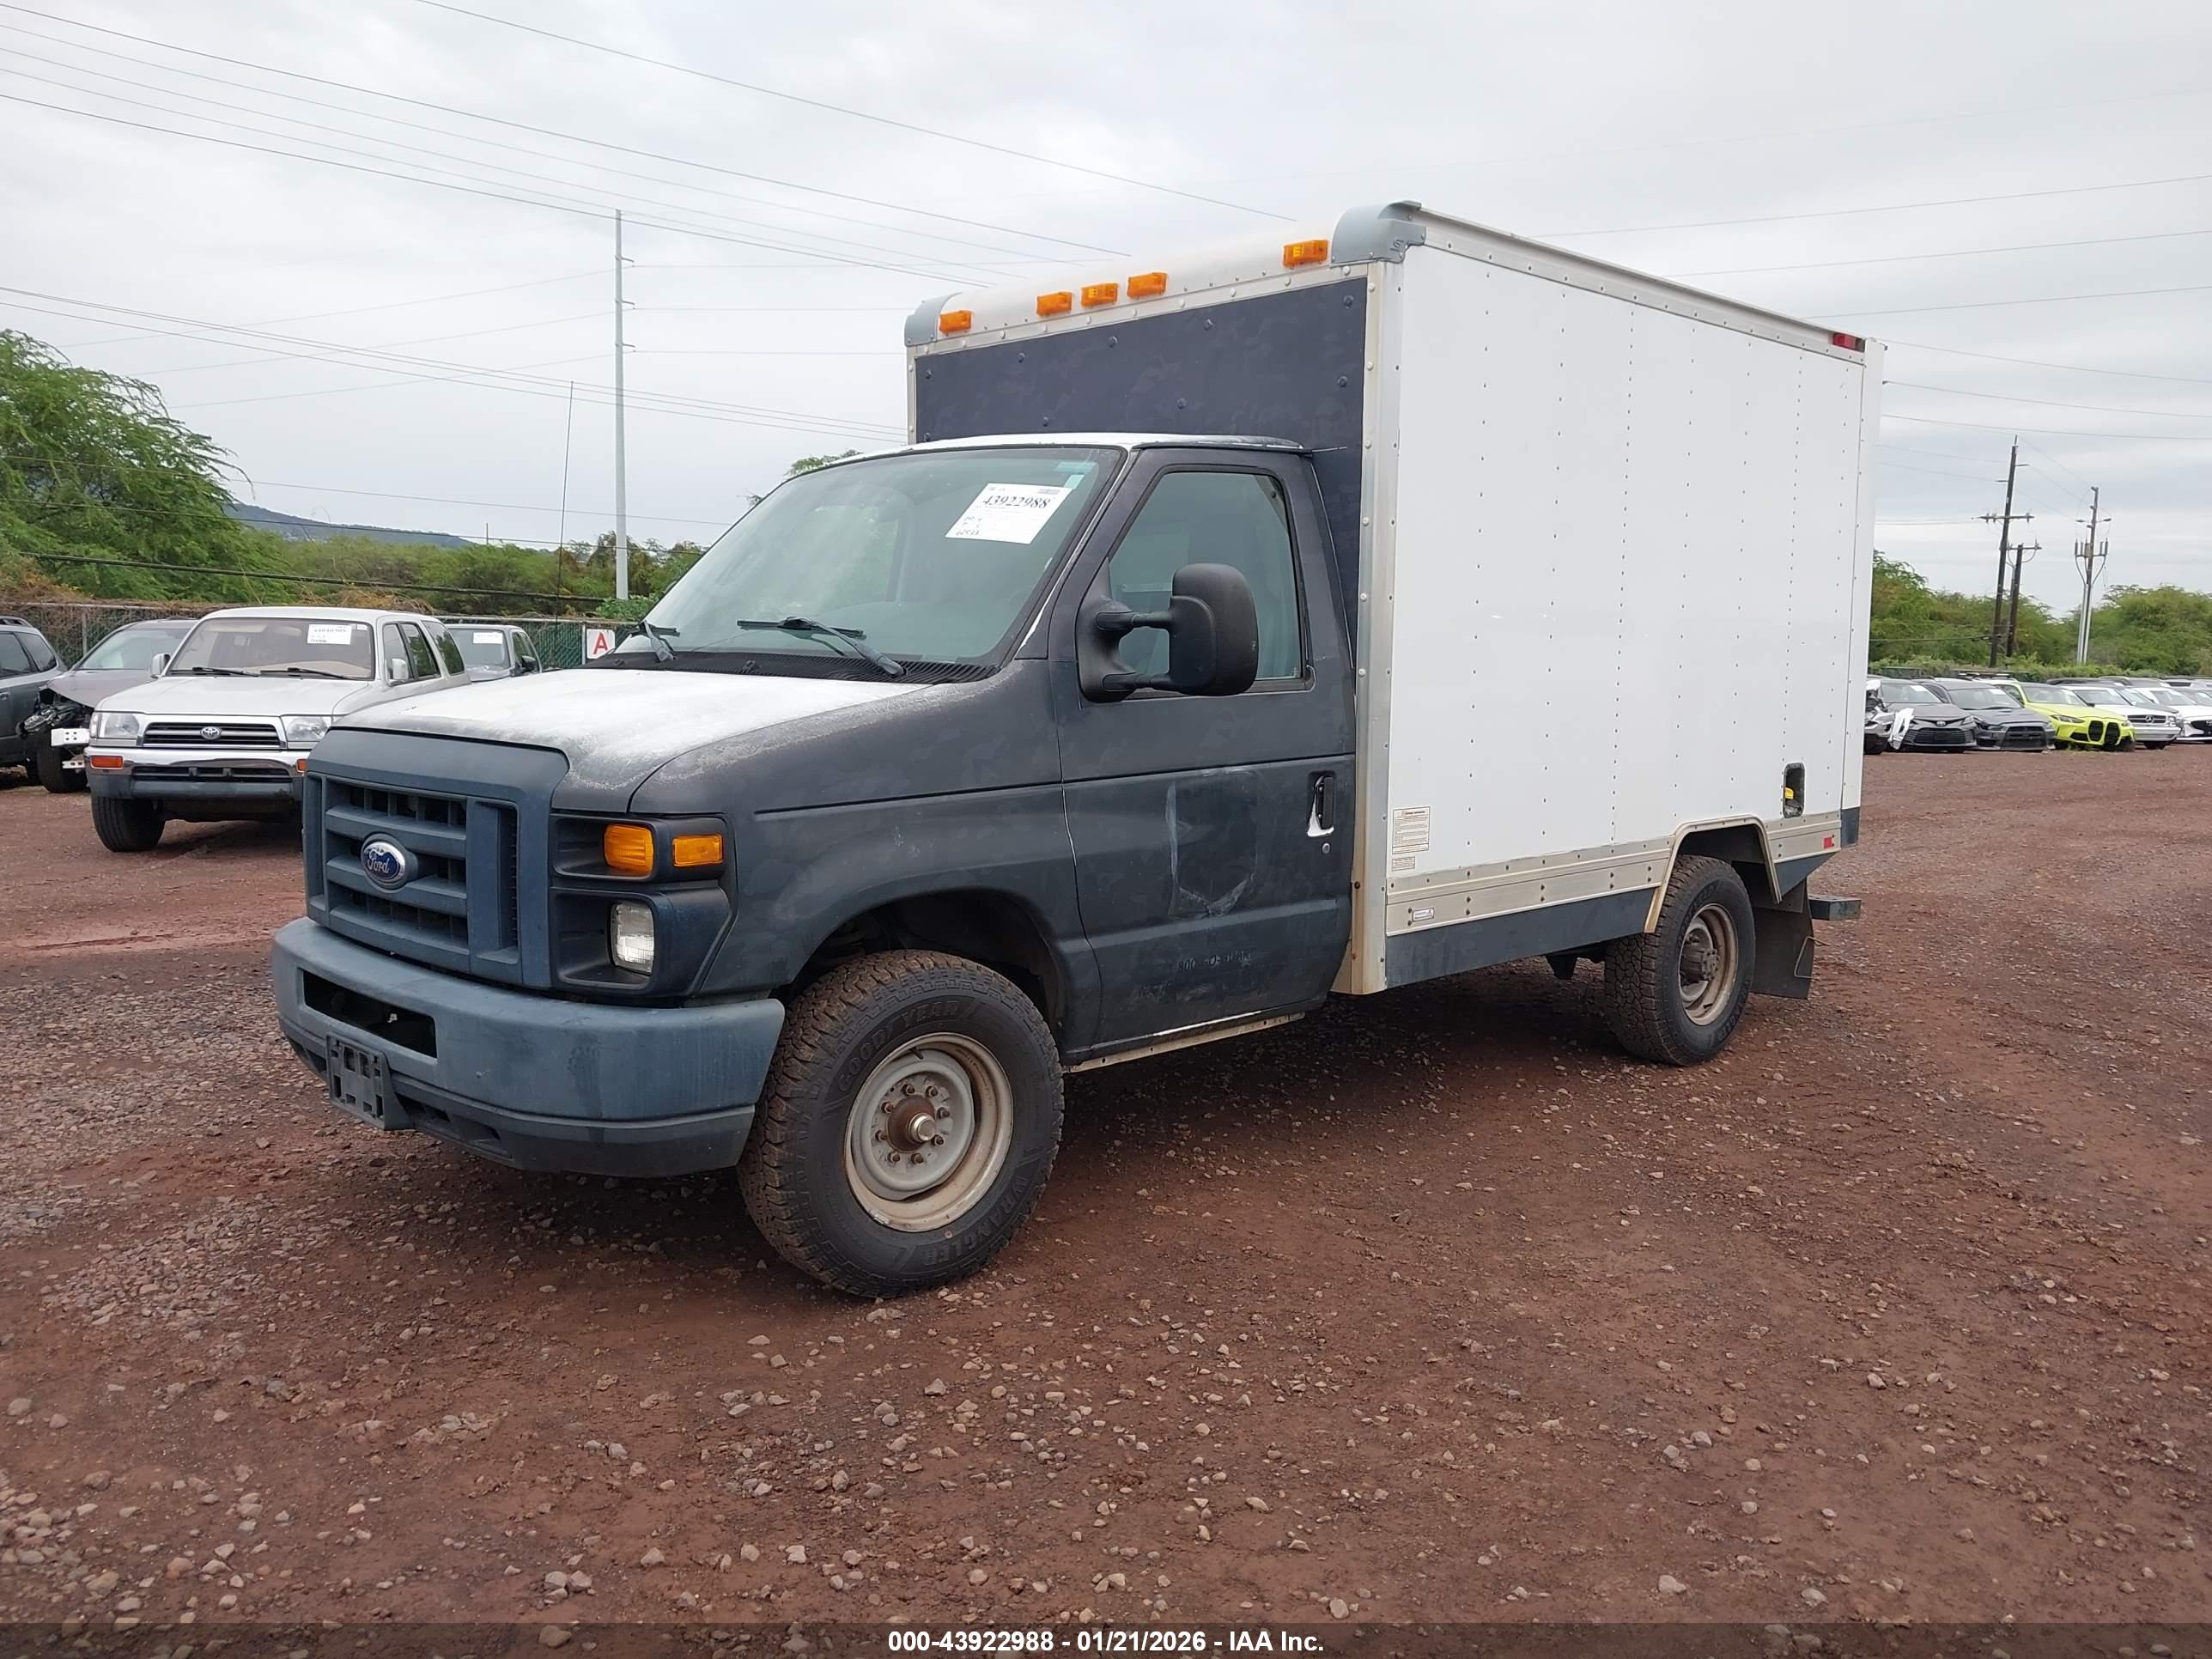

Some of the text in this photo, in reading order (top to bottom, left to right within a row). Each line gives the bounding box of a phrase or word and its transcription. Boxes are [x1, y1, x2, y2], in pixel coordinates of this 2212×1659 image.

[983, 495, 1051, 509] 43922988
[592, 631, 609, 655] A
[367, 848, 391, 874] Ford
